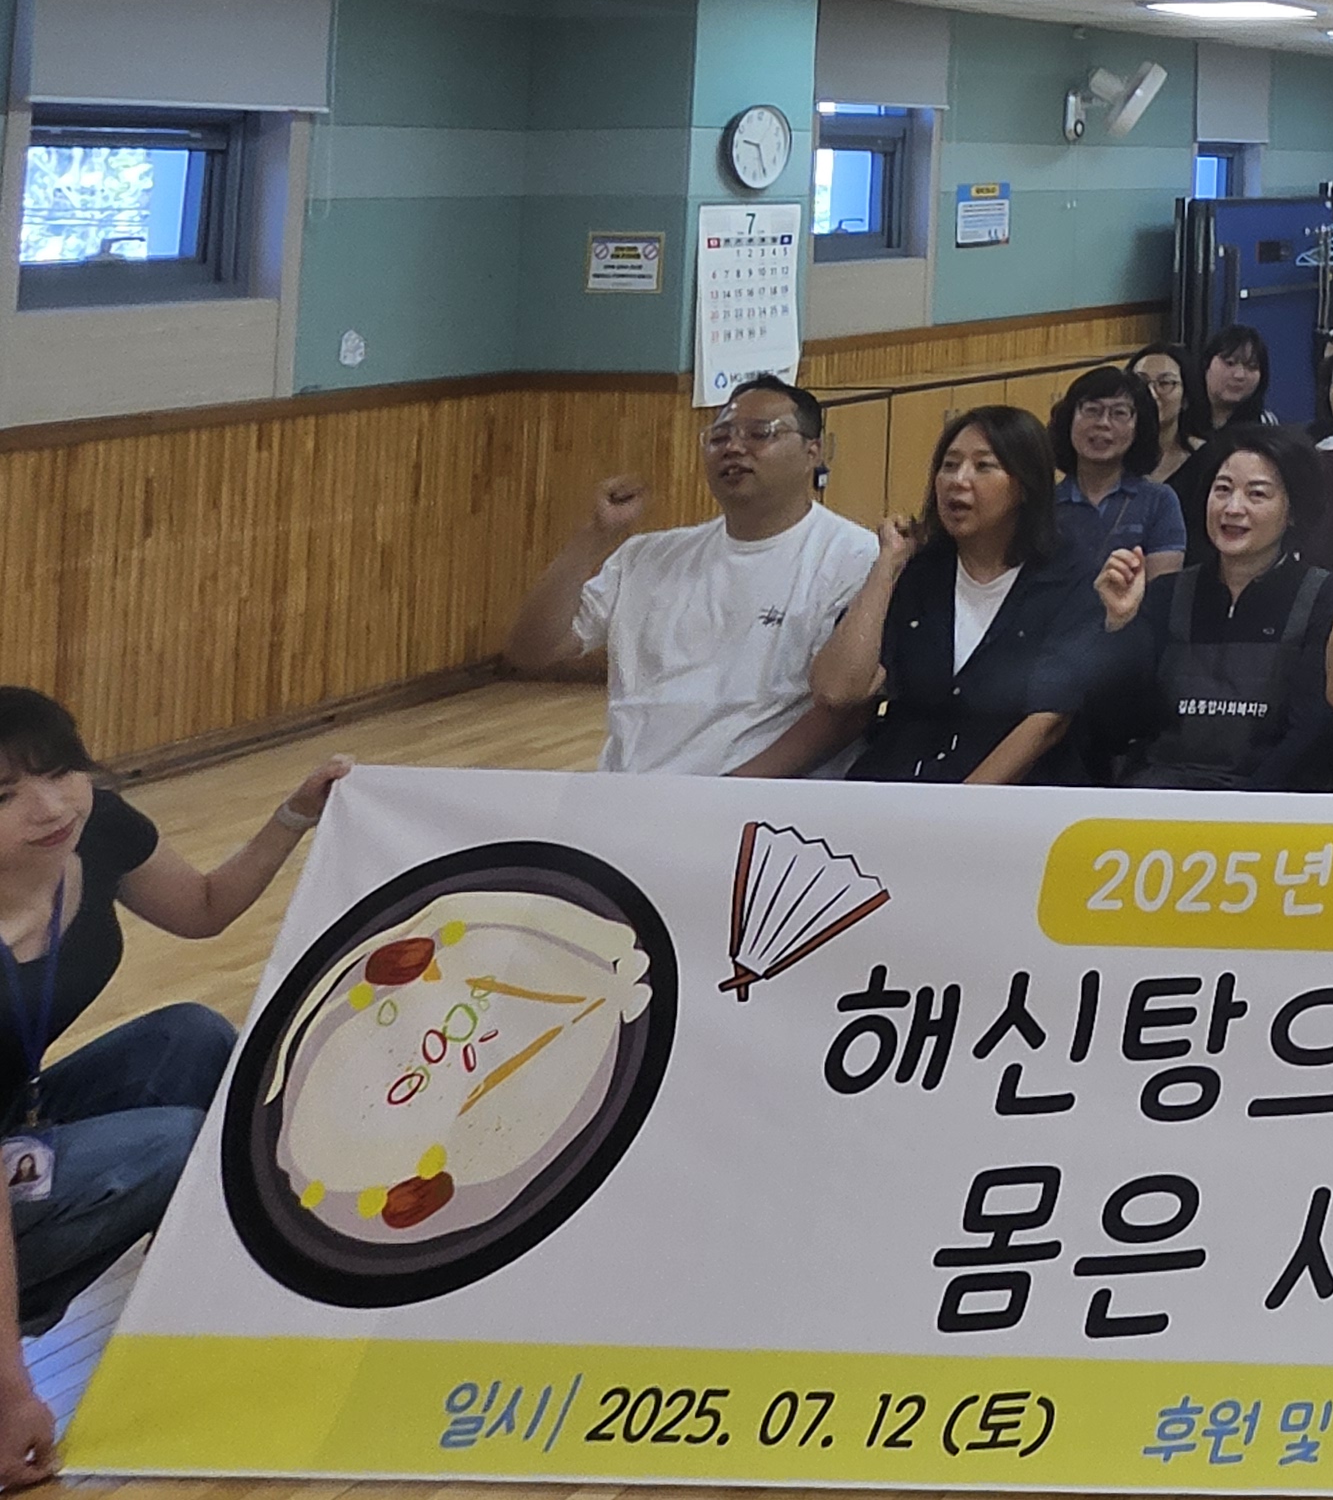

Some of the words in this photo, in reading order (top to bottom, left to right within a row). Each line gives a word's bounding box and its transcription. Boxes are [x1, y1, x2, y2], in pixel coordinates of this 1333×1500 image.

[746, 213, 756, 235] 7
[736, 269, 741, 278] 8
[781, 266, 789, 275] 12
[747, 249, 753, 258] 2
[760, 248, 765, 257] 3
[772, 248, 777, 256] 4
[1178, 698, 1269, 718] 길음종합사회복지관
[1086, 843, 1333, 918] 2025년
[932, 1164, 1207, 1340] 몸은
[439, 1380, 553, 1449] 일시
[584, 1386, 731, 1446] 2025.
[758, 1390, 834, 1449] 07.
[942, 1391, 1056, 1458] (토)
[1142, 1395, 1261, 1465] 후원
[1277, 1399, 1333, 1467] 및
